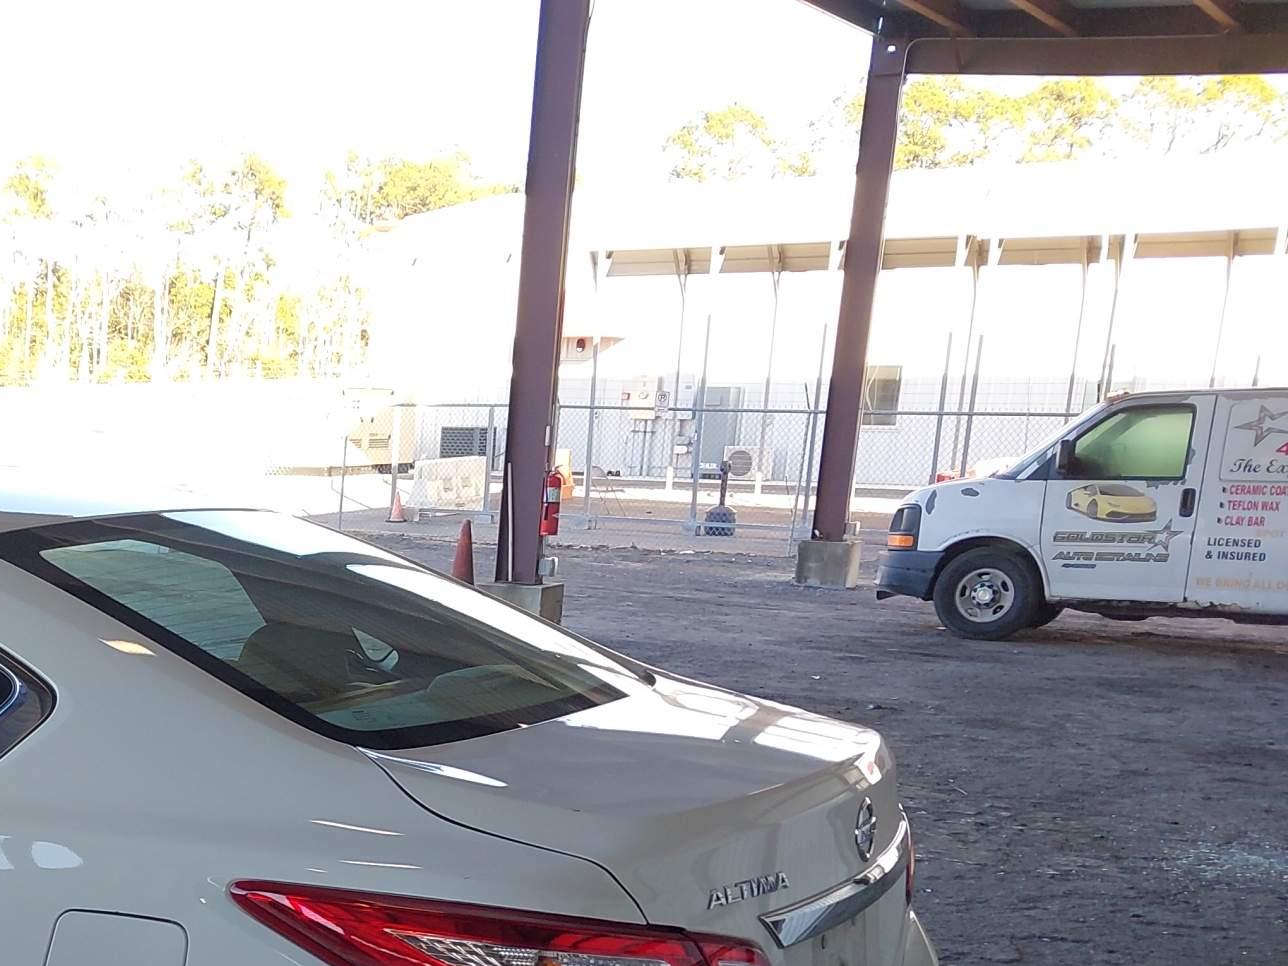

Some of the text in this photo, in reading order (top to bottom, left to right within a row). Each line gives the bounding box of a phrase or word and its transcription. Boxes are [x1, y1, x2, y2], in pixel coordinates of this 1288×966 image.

[1229, 458, 1262, 473] The
[1229, 484, 1268, 496] CERAMIC
[1227, 500, 1281, 512] TEFLON WAX
[1224, 515, 1266, 527] CLAY BAR
[1207, 537, 1261, 548] LICENSED
[1051, 551, 1094, 561] AUTO
[1204, 550, 1267, 562] & INSURED
[707, 871, 790, 910] ALTIMA
